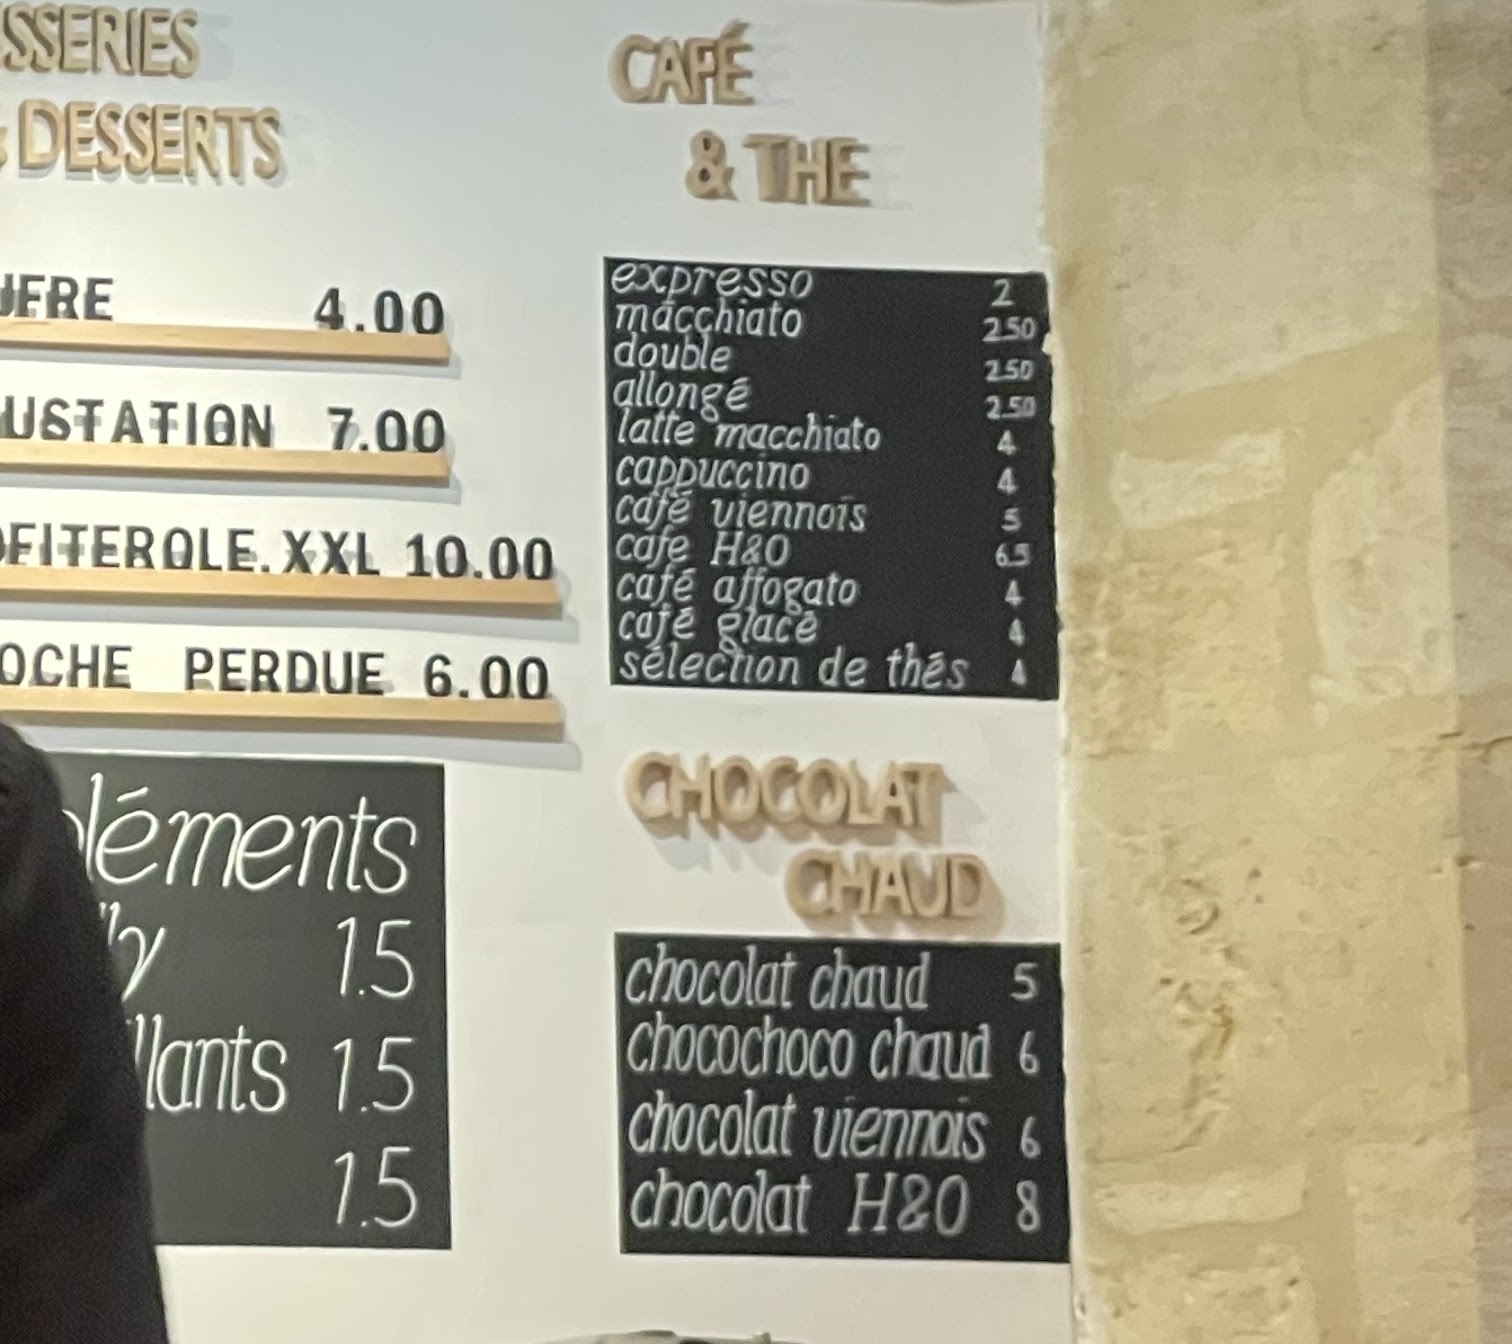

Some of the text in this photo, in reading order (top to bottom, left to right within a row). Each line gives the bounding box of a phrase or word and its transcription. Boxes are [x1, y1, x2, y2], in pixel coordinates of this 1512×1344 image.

[608, 17, 755, 106] CAFÉ
[17, 98, 284, 181] DESSERTS
[685, 129, 872, 207] & THE
[313, 287, 446, 335] 4.00
[611, 262, 1015, 307] expresso 2
[615, 297, 805, 338] macchiato
[613, 331, 732, 373] double
[613, 369, 752, 423] allongé
[326, 406, 447, 455] 7.00
[617, 408, 1017, 456] latte macchiato 4
[615, 454, 1019, 497] cappuccino 4
[615, 486, 1022, 532] café viennois 5
[404, 534, 554, 581] 10.00
[709, 530, 792, 567] H&O
[616, 563, 1025, 616] café affogato 4
[619, 604, 698, 650] café
[716, 607, 819, 655] glacé
[184, 646, 386, 698] PERDUE
[422, 655, 550, 700] 6.00
[619, 642, 801, 686] sélection
[818, 645, 870, 689] de
[886, 642, 971, 691] thés
[625, 751, 951, 838] CHOCOLAT
[62, 772, 418, 895] léments
[784, 848, 998, 926] CHAUD
[336, 915, 416, 999] 1.5
[625, 941, 1039, 1011] chocolat chaud 5
[625, 1009, 1041, 1082] chocochoco chaud 6
[332, 1036, 416, 1113] 1.5
[627, 1088, 1042, 1162] chocolat viennois 6
[333, 1145, 419, 1229] 1.5
[629, 1166, 1042, 1237] chocolat H&O 8
